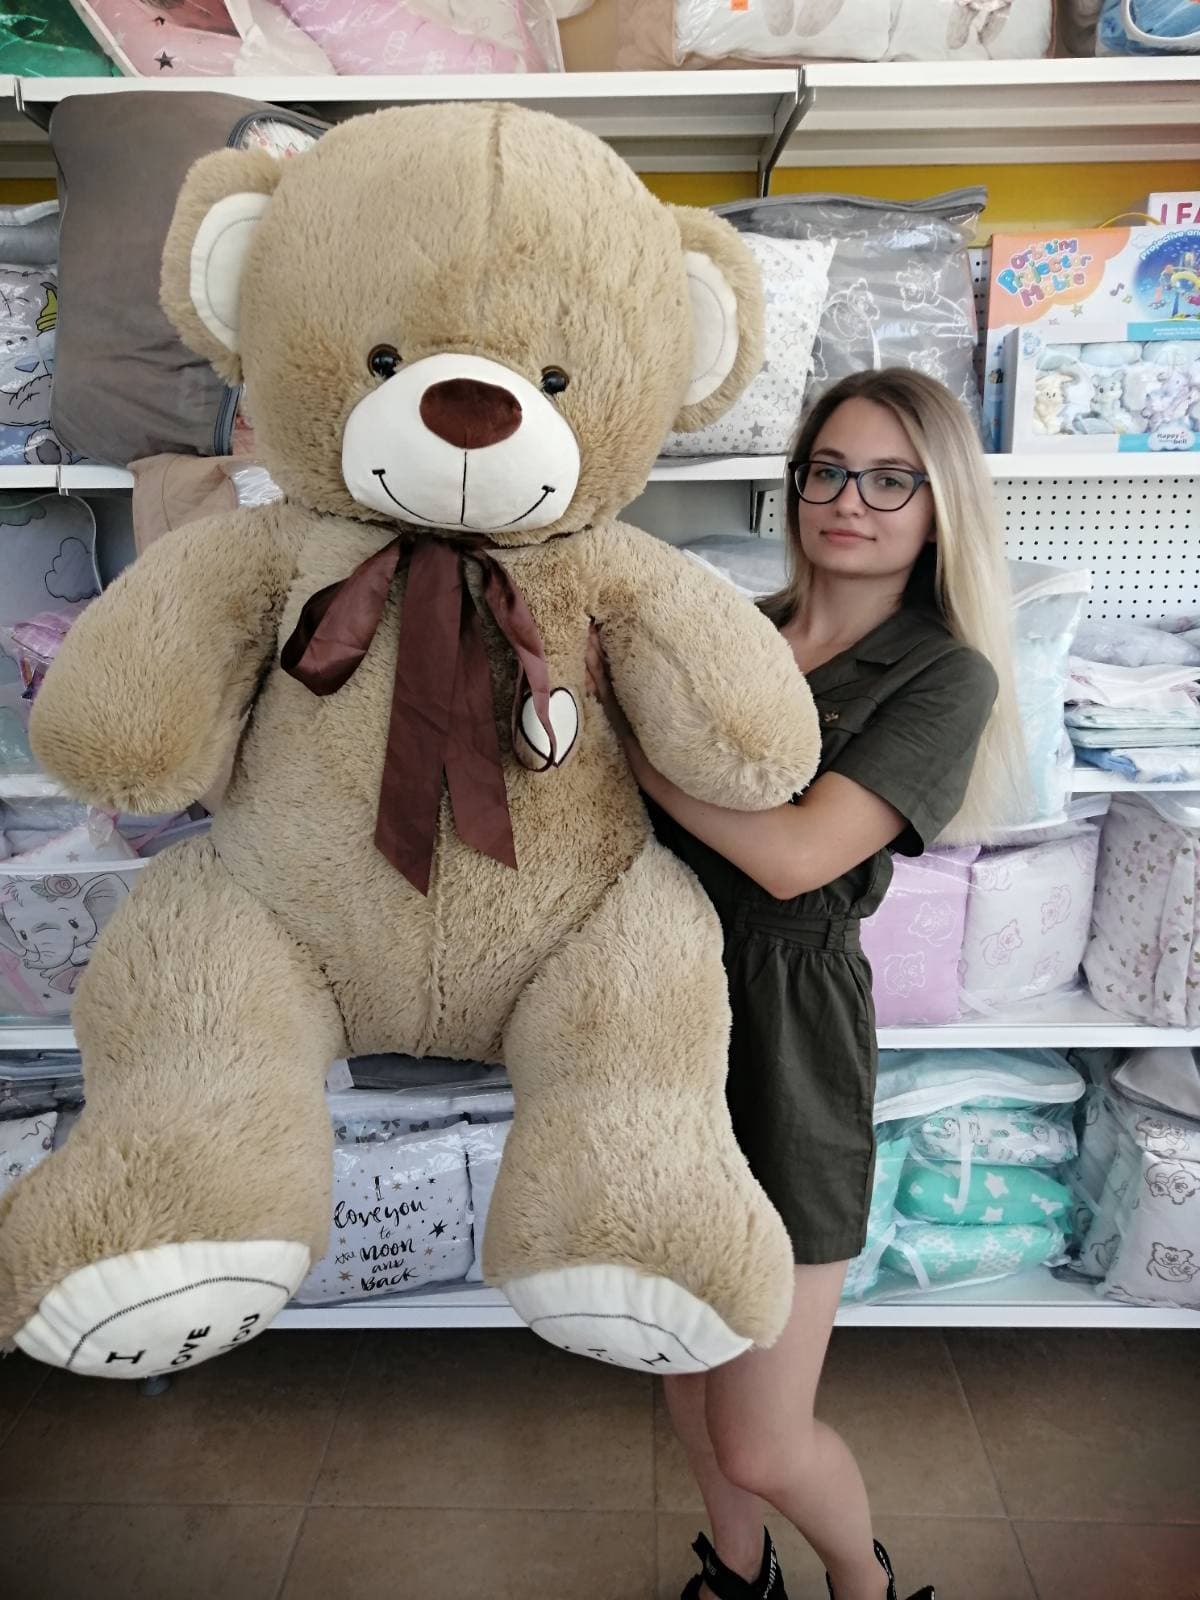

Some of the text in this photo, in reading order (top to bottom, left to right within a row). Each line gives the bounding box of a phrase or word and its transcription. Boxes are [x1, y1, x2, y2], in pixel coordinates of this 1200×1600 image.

[1010, 239, 1077, 269] Orbiting
[997, 254, 1092, 295] Projector
[1020, 273, 1085, 308] Mobile
[372, 1174, 385, 1202] I
[380, 1225, 394, 1240] to
[105, 1350, 147, 1364] I
